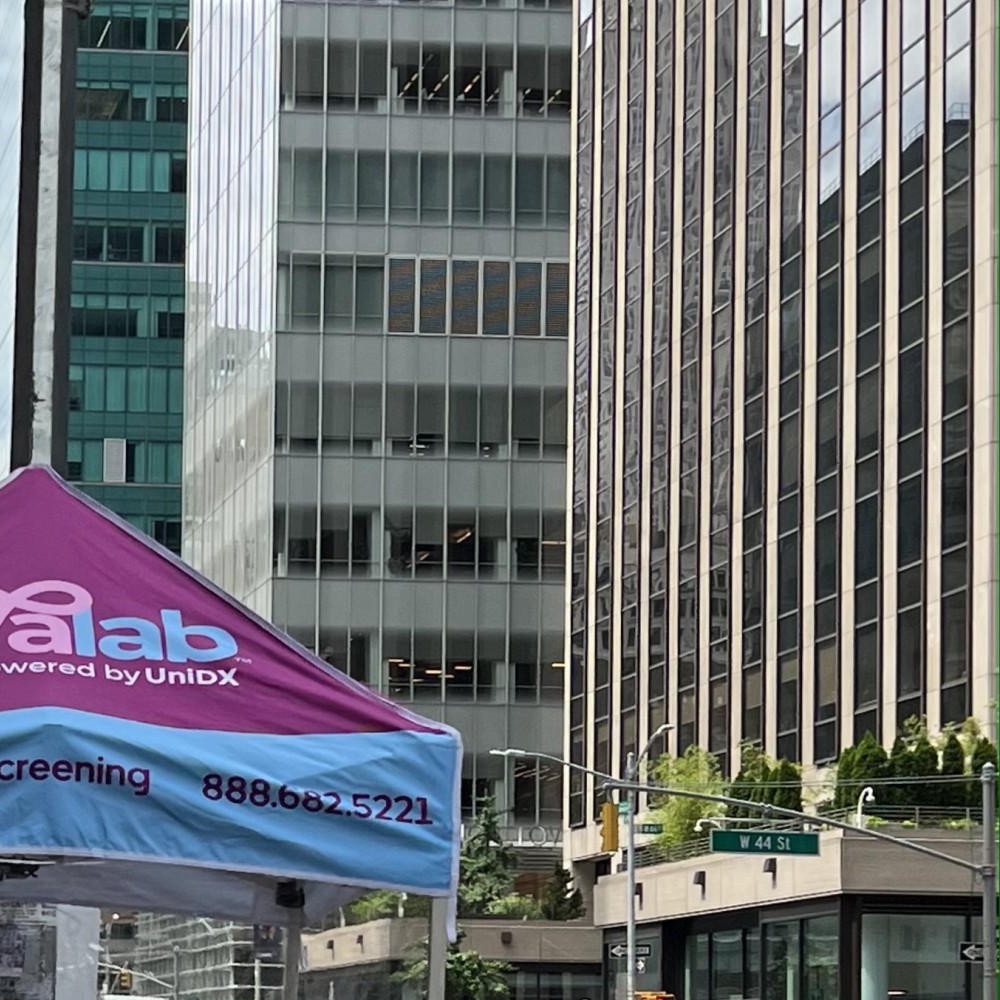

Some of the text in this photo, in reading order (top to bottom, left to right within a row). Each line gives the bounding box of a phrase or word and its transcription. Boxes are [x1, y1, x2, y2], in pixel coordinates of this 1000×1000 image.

[104, 664, 141, 685] by
[145, 667, 240, 687] UniDX
[202, 773, 433, 826] 888.682.5221
[739, 836, 791, 850] W 44 St
